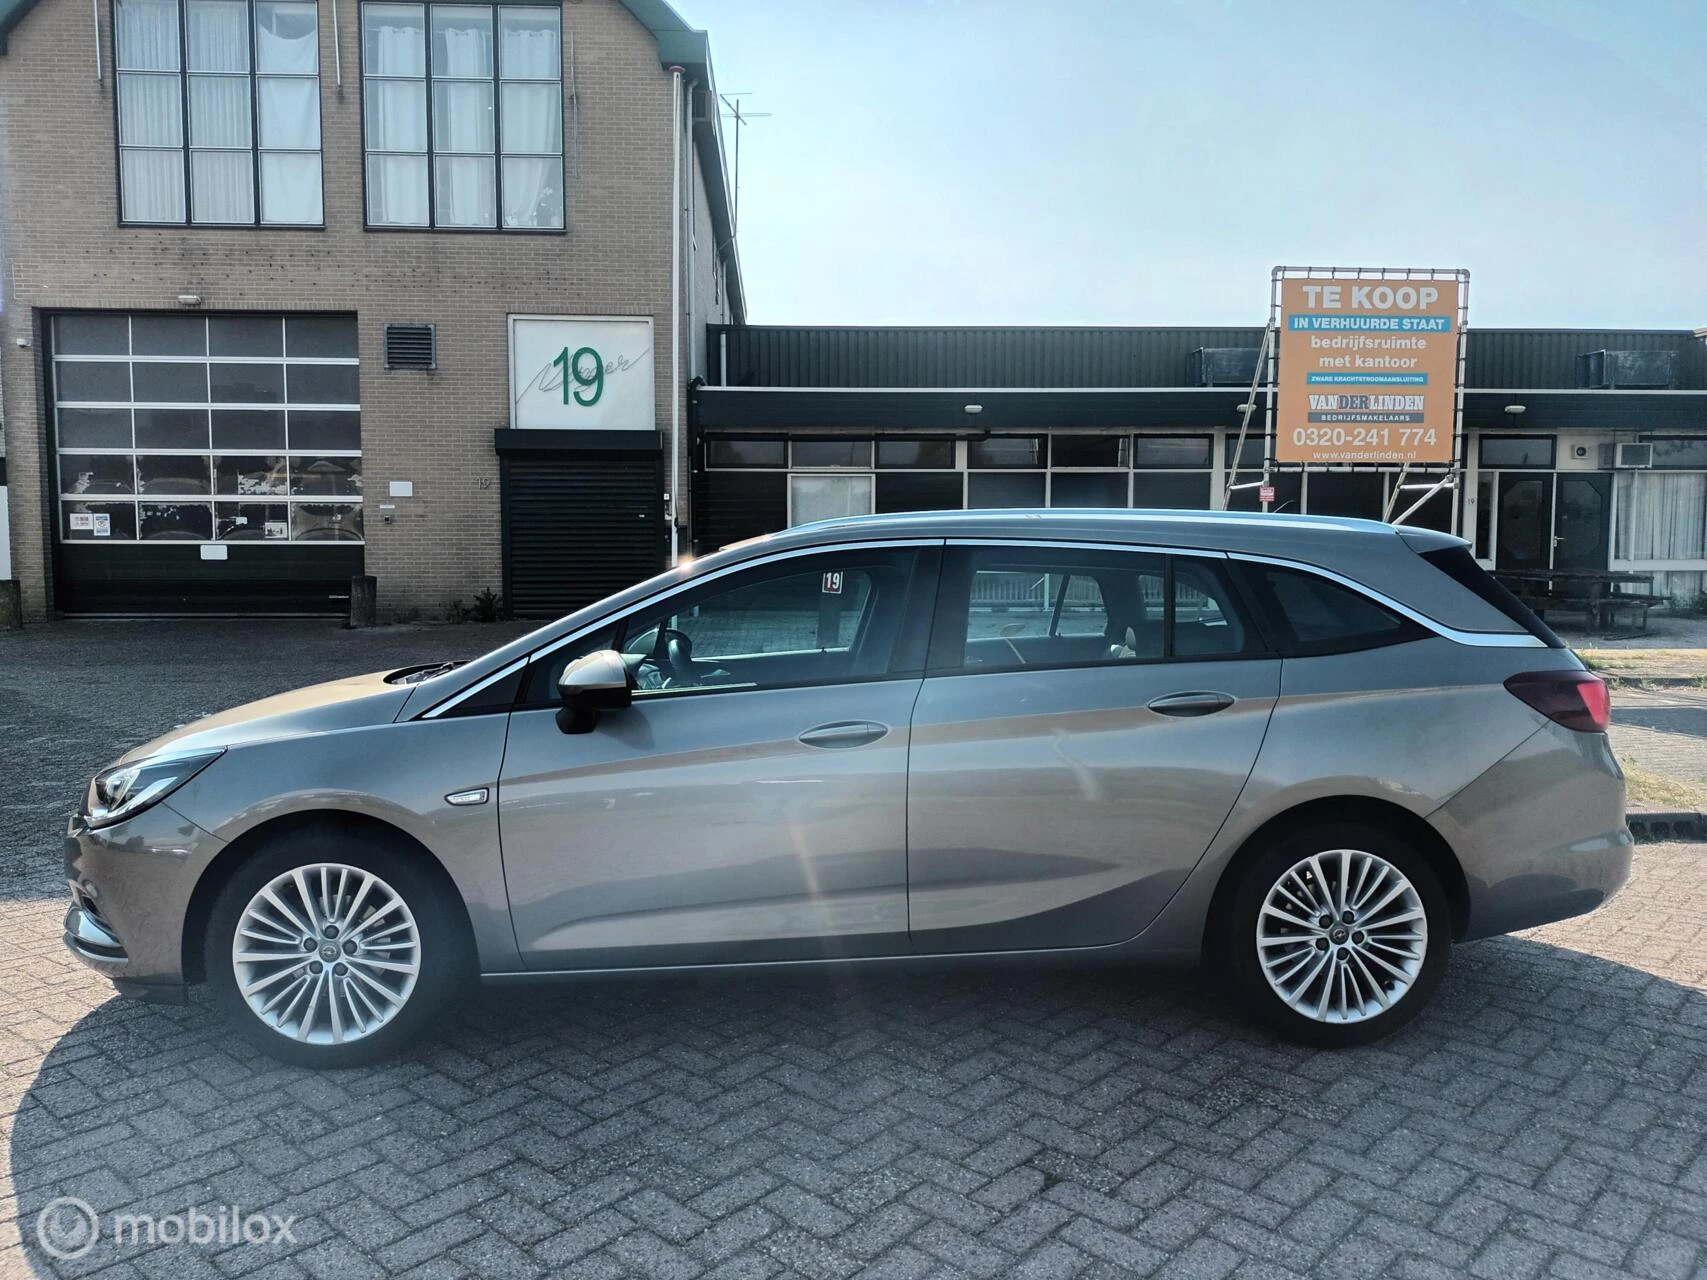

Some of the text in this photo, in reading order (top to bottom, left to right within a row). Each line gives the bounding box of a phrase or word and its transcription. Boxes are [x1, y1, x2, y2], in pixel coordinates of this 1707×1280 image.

[1302, 285, 1439, 310] TE KOOP
[1294, 317, 1445, 331] IN VERHUURDE STAAT
[1311, 335, 1427, 350] bedrijfsruimte
[1319, 355, 1418, 369] met kantoor
[553, 346, 604, 407] 19
[1321, 414, 1411, 422] BEDRIJFSMAKELAARS
[1292, 427, 1437, 446] 0320-241 774
[1313, 450, 1417, 460] www.vanderlinden.nl
[826, 572, 840, 589] 19
